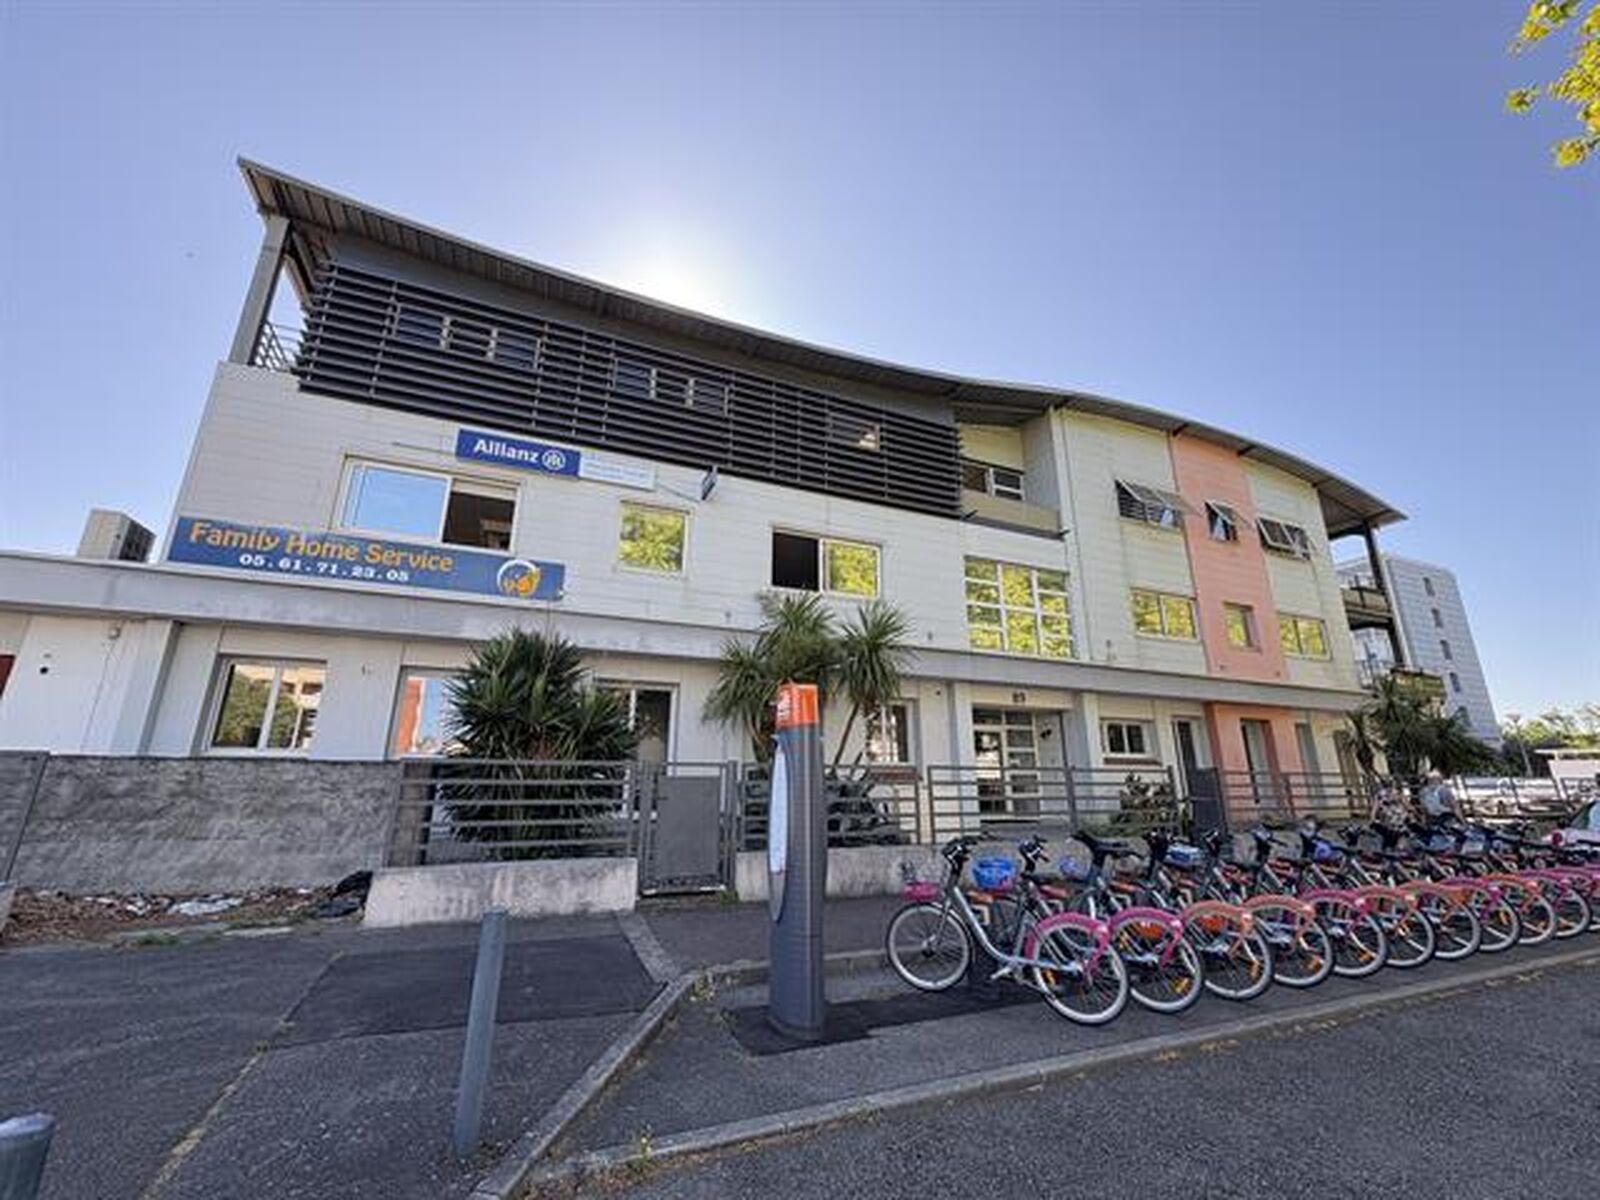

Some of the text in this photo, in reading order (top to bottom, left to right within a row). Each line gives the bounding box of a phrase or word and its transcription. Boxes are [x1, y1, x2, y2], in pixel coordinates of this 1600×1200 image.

[473, 439, 540, 463] Allianz
[189, 521, 454, 572] Family Home Service
